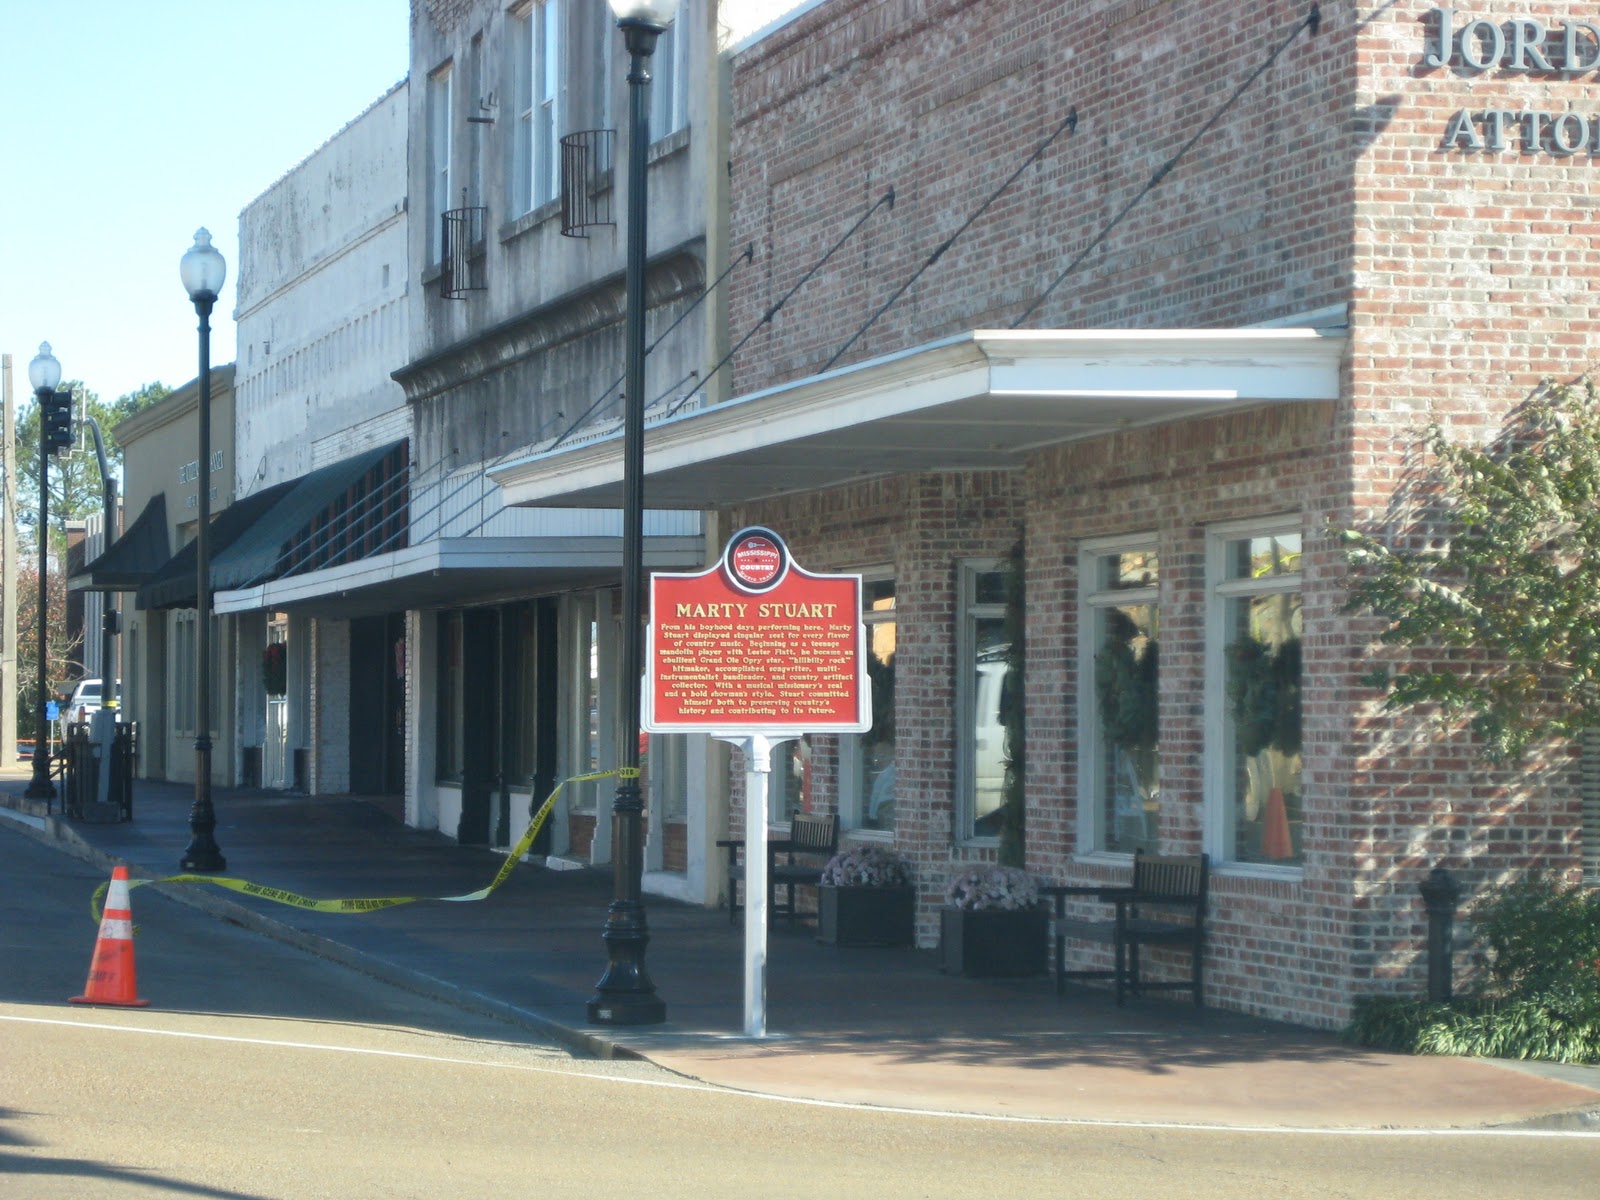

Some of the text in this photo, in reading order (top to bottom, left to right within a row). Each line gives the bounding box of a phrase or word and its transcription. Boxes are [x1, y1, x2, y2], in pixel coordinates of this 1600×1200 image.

[1425, 8, 1600, 71] JORD
[1446, 108, 1600, 152] ATTO
[737, 549, 778, 559] MISSISSIPPI
[677, 603, 836, 618] MARTY STUART
[700, 624, 733, 632] boyhood
[736, 624, 754, 632] days
[758, 624, 801, 632] performing
[829, 624, 852, 632] Marty
[693, 632, 730, 640] displayed
[733, 632, 764, 640] singular
[686, 640, 716, 648] country
[749, 640, 786, 648] Beginning
[810, 640, 840, 648] teenage
[659, 648, 694, 656] mandolin
[698, 648, 722, 657] player
[726, 648, 744, 656] with
[747, 648, 771, 656] Lester
[801, 648, 811, 656] he
[813, 648, 841, 656] became
[662, 656, 696, 664] ebullient
[700, 656, 723, 664] Grand
[726, 656, 739, 664] Ole
[742, 656, 762, 665] Opry
[715, 665, 765, 674] accomplished
[789, 674, 819, 682] country
[684, 698, 713, 706] himself
[716, 698, 735, 706] both
[738, 698, 747, 706] to
[750, 698, 790, 707] preserving
[678, 707, 707, 716] history
[728, 707, 776, 716] contributing
